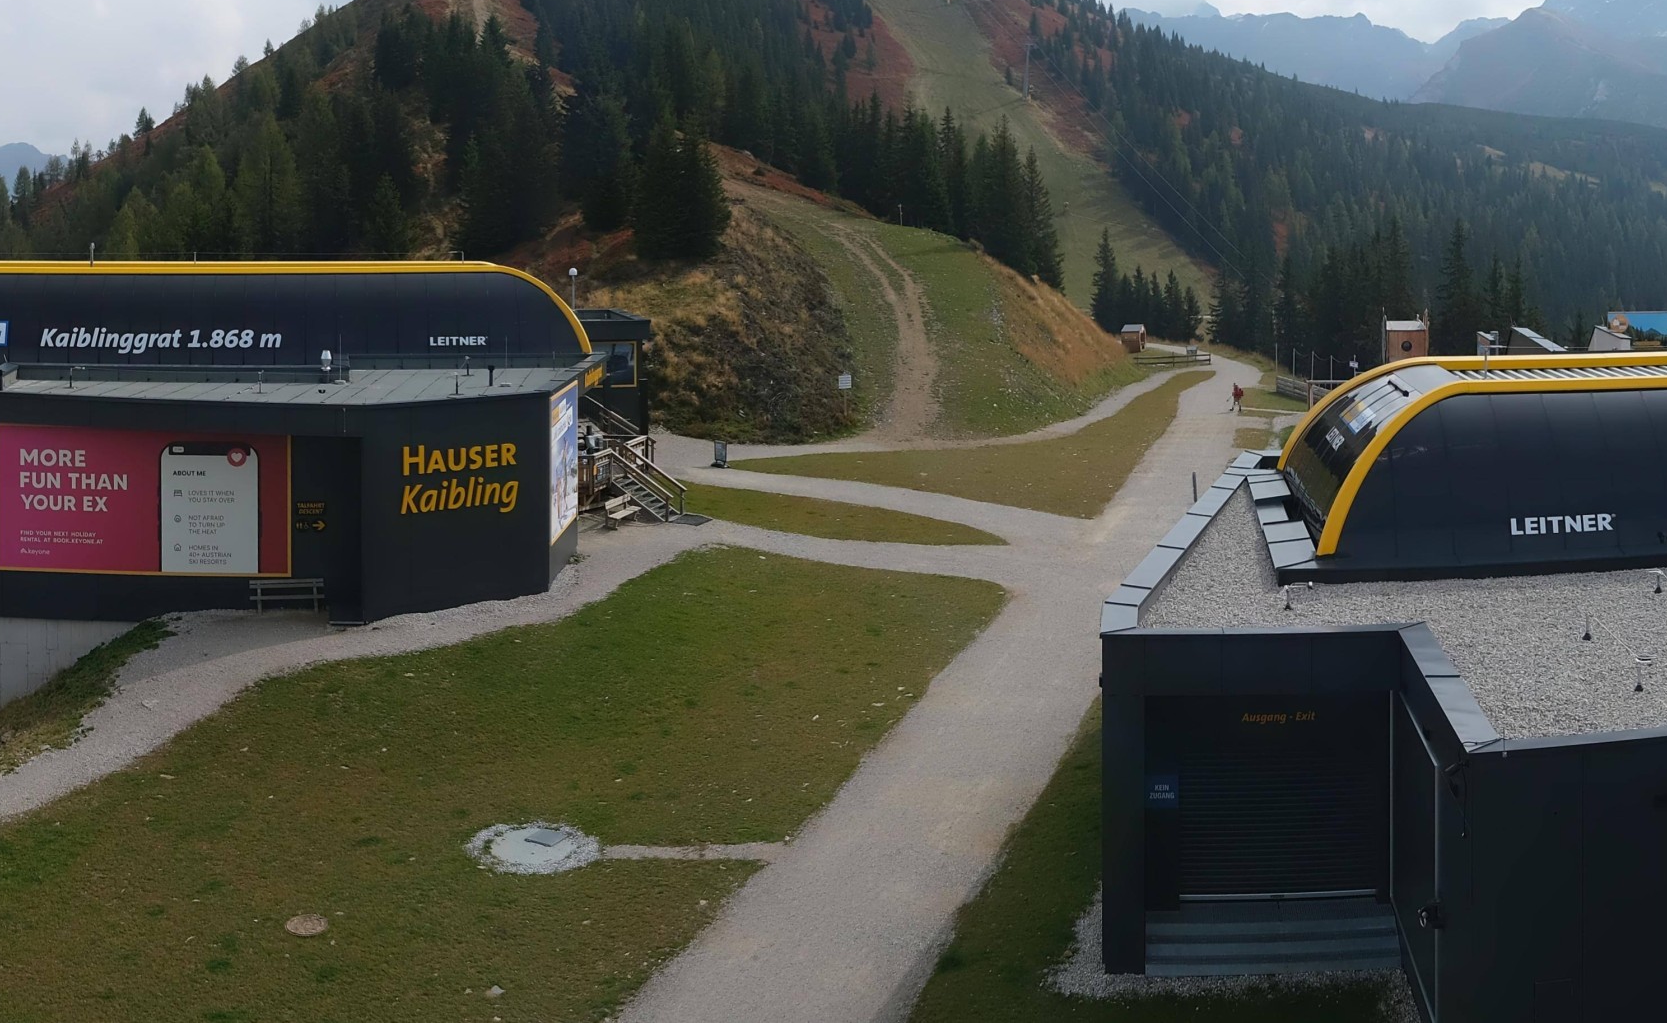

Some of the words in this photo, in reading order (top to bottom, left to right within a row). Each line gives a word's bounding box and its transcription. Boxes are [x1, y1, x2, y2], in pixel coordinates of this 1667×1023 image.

[40, 326, 182, 354] Kaiblinggrat
[187, 329, 254, 348] 1.868
[260, 332, 282, 348] m
[429, 336, 487, 346] LEITNER
[19, 448, 86, 468] MORE
[403, 443, 517, 476] HAUSER
[19, 472, 61, 489] FUN
[68, 473, 128, 490] THAN
[21, 494, 77, 511] YOUR
[83, 496, 108, 512] EX
[401, 477, 519, 514] Kaibling
[1510, 513, 1613, 536] LEITNER
[1242, 712, 1287, 724] Ausgang
[1295, 711, 1316, 721] Exit
